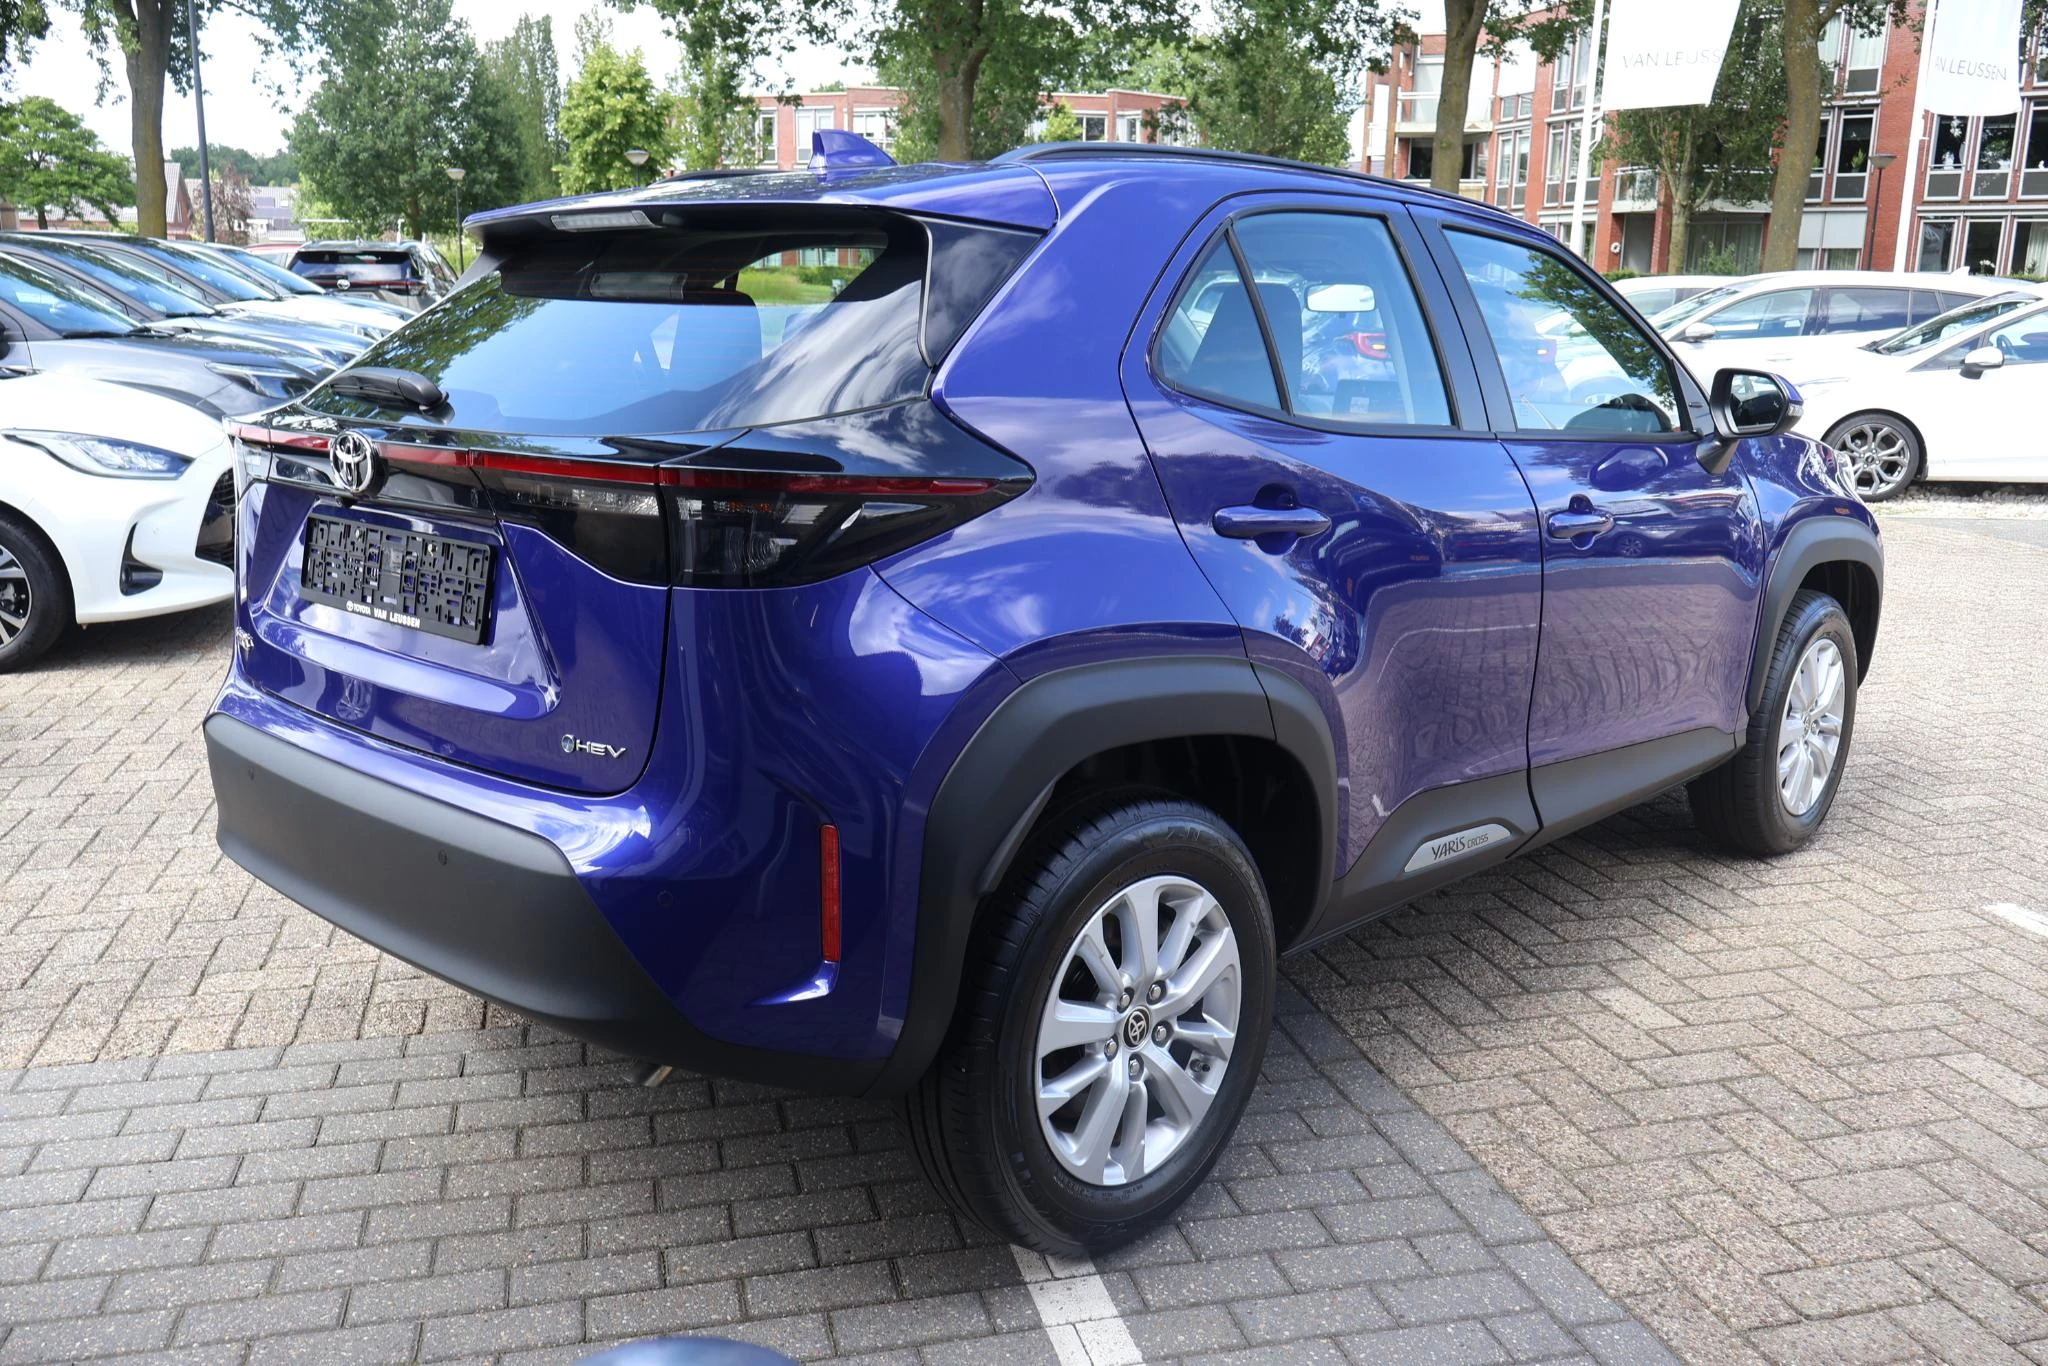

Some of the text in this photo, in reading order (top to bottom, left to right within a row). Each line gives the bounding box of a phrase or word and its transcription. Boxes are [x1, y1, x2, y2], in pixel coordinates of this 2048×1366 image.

[1622, 52, 1660, 68] VAN
[1949, 58, 2007, 81] LEUSSEN
[353, 603, 421, 629] TOYOTA VAN LEUSSEN
[575, 739, 627, 759] HEV
[1467, 833, 1489, 849] CROSS
